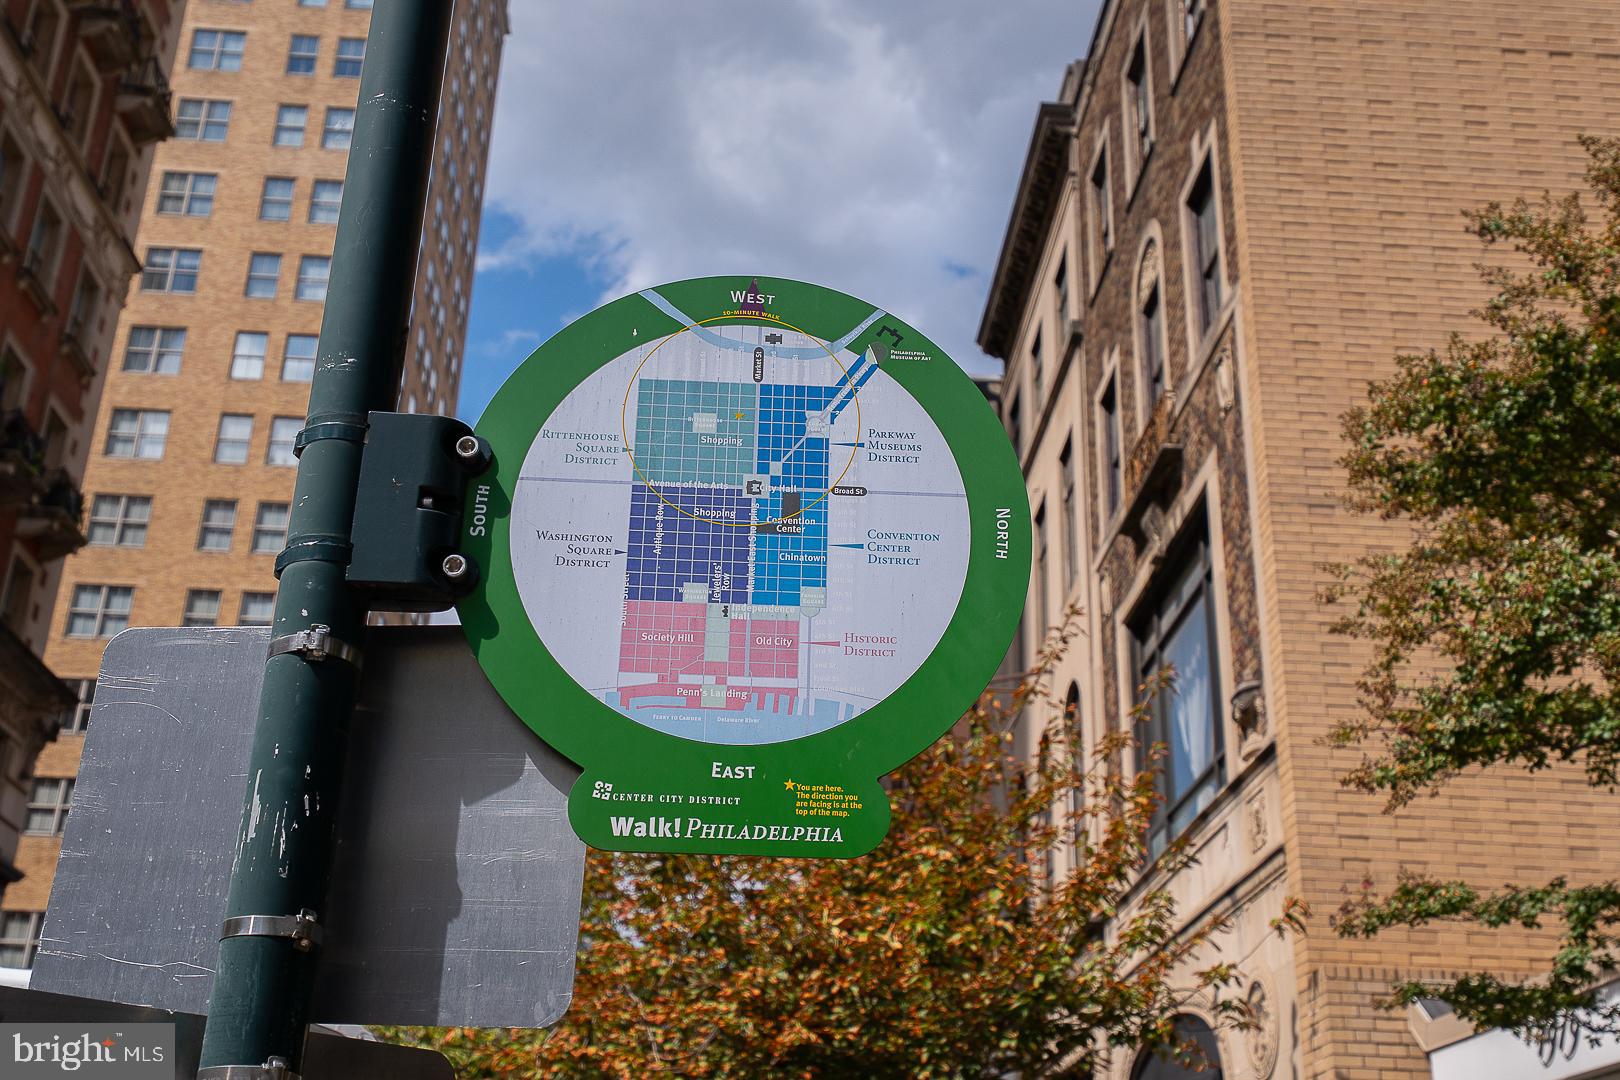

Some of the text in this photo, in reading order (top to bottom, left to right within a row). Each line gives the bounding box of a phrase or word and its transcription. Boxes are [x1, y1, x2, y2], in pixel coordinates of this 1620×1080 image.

[730, 290, 775, 305] WEST
[723, 310, 781, 320] 10-MINUTE WALK
[754, 350, 762, 381] Market St
[542, 430, 620, 442] RITTENHOUSE
[868, 428, 916, 440] PARKWAY
[700, 436, 743, 446] Shopping
[868, 441, 922, 452] MUSEUMS
[576, 442, 620, 454] SQUARE
[565, 454, 618, 465] DISTRICT
[868, 452, 920, 464] DISTRICT
[650, 479, 728, 490] Avenue of the Arts
[780, 484, 797, 492] Hall
[470, 485, 490, 536] SOUTH
[694, 508, 736, 518] Shopping
[766, 516, 816, 526] Convention
[653, 503, 664, 555] Antique Row
[776, 524, 805, 534] Center
[996, 507, 1011, 560] NORTH
[536, 530, 612, 542] WASHINGTON
[868, 529, 940, 542] CONVENTION
[567, 544, 612, 556] SQUARE
[746, 503, 760, 592] Market East Shopping
[868, 542, 910, 553] CENTER
[555, 556, 610, 568] DISTRICT
[779, 552, 826, 562] Chinatown
[868, 554, 920, 566] DISTRICT
[712, 562, 722, 602] Jewelers'
[722, 572, 730, 590] Row
[732, 604, 795, 614] Independence
[732, 612, 750, 620] Hall
[642, 632, 694, 643] Society Hill
[756, 636, 792, 648] Old City
[844, 632, 897, 645] HISTORIC
[844, 646, 896, 657] DISTRICT
[676, 688, 748, 700] Penn's Landing
[712, 762, 755, 779] EAST
[796, 783, 810, 792] You
[826, 784, 844, 792] here.
[613, 793, 740, 805] CENTER CITY DISTRICT
[796, 792, 858, 802] The direction you
[809, 800, 832, 810] facing
[796, 808, 806, 817] top
[818, 808, 830, 816] the
[832, 810, 850, 818] map.
[610, 816, 844, 842] Walk! PHILADELPHIA
